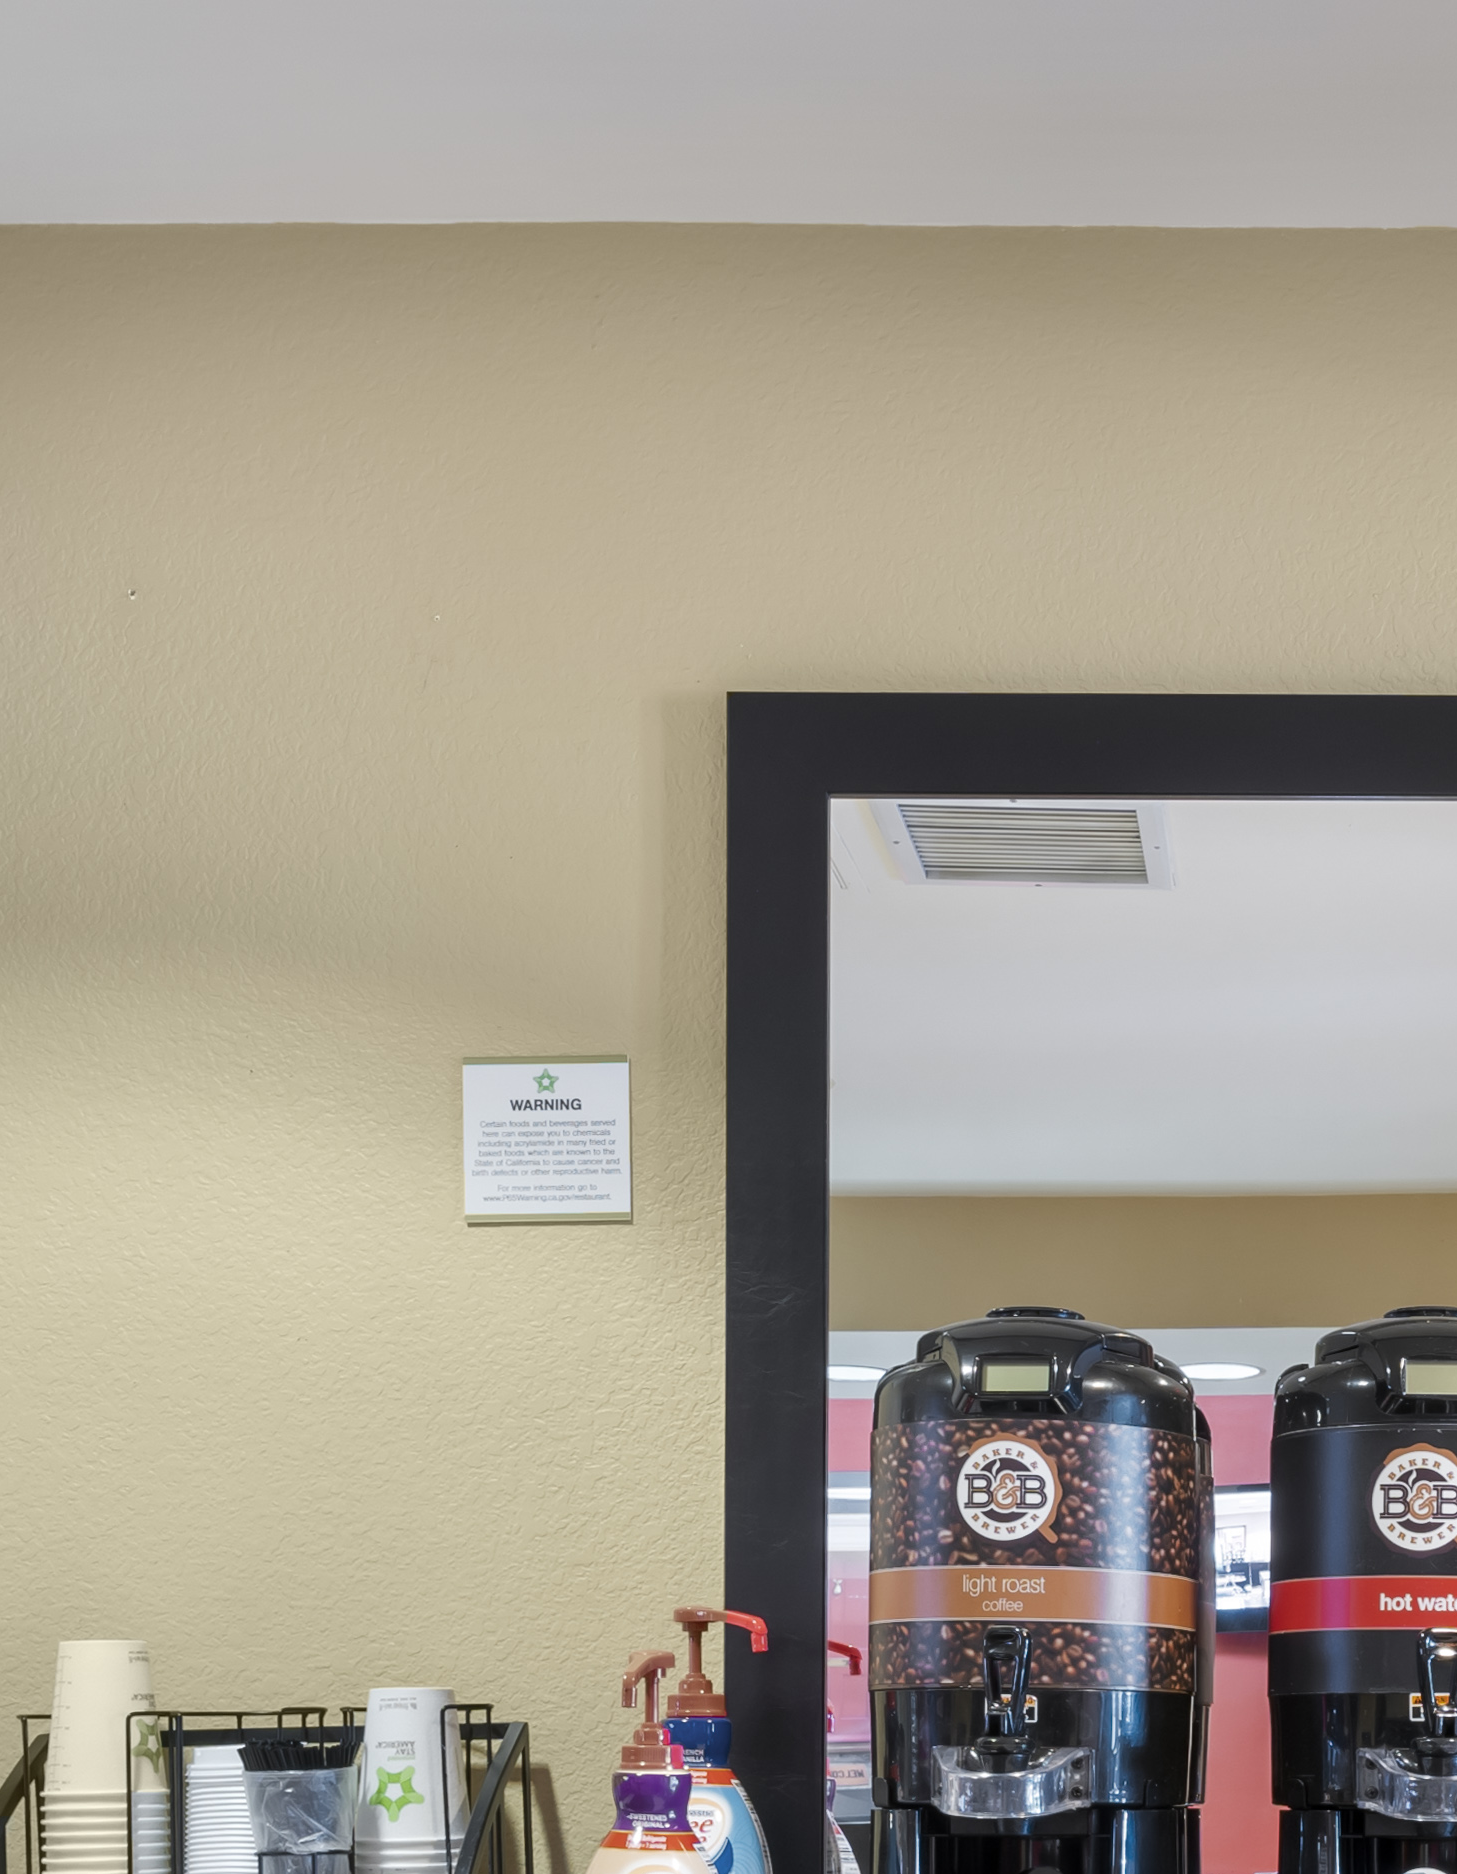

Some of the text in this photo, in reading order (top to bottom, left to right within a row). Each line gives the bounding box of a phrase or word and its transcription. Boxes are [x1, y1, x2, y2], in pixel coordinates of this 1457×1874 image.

[510, 1098, 582, 1111] WARNING
[532, 1119, 547, 1128] and
[549, 1119, 588, 1128] beverages
[590, 1119, 616, 1127] served
[482, 1130, 500, 1138] here
[547, 1130, 561, 1138] you
[566, 1139, 587, 1147] many
[527, 1149, 550, 1157] which
[566, 1148, 591, 1156] known
[593, 1148, 601, 1156] to
[603, 1147, 615, 1155] the
[505, 1158, 541, 1166] California
[542, 1158, 550, 1166] to
[605, 1157, 620, 1165] and
[530, 1168, 551, 1176] other
[497, 1184, 510, 1192] For
[533, 1183, 576, 1192] information
[577, 1184, 588, 1192] go
[589, 1183, 598, 1191] to
[972, 1447, 1025, 1471] BAKER
[1387, 1457, 1441, 1482] BAKER
[963, 1472, 1048, 1510] B&B
[971, 1512, 1040, 1535] BREWER
[1386, 1522, 1457, 1546] BREWER
[962, 1574, 1046, 1597] light roast
[982, 1598, 1024, 1612] coffee
[1379, 1593, 1413, 1612] hot
